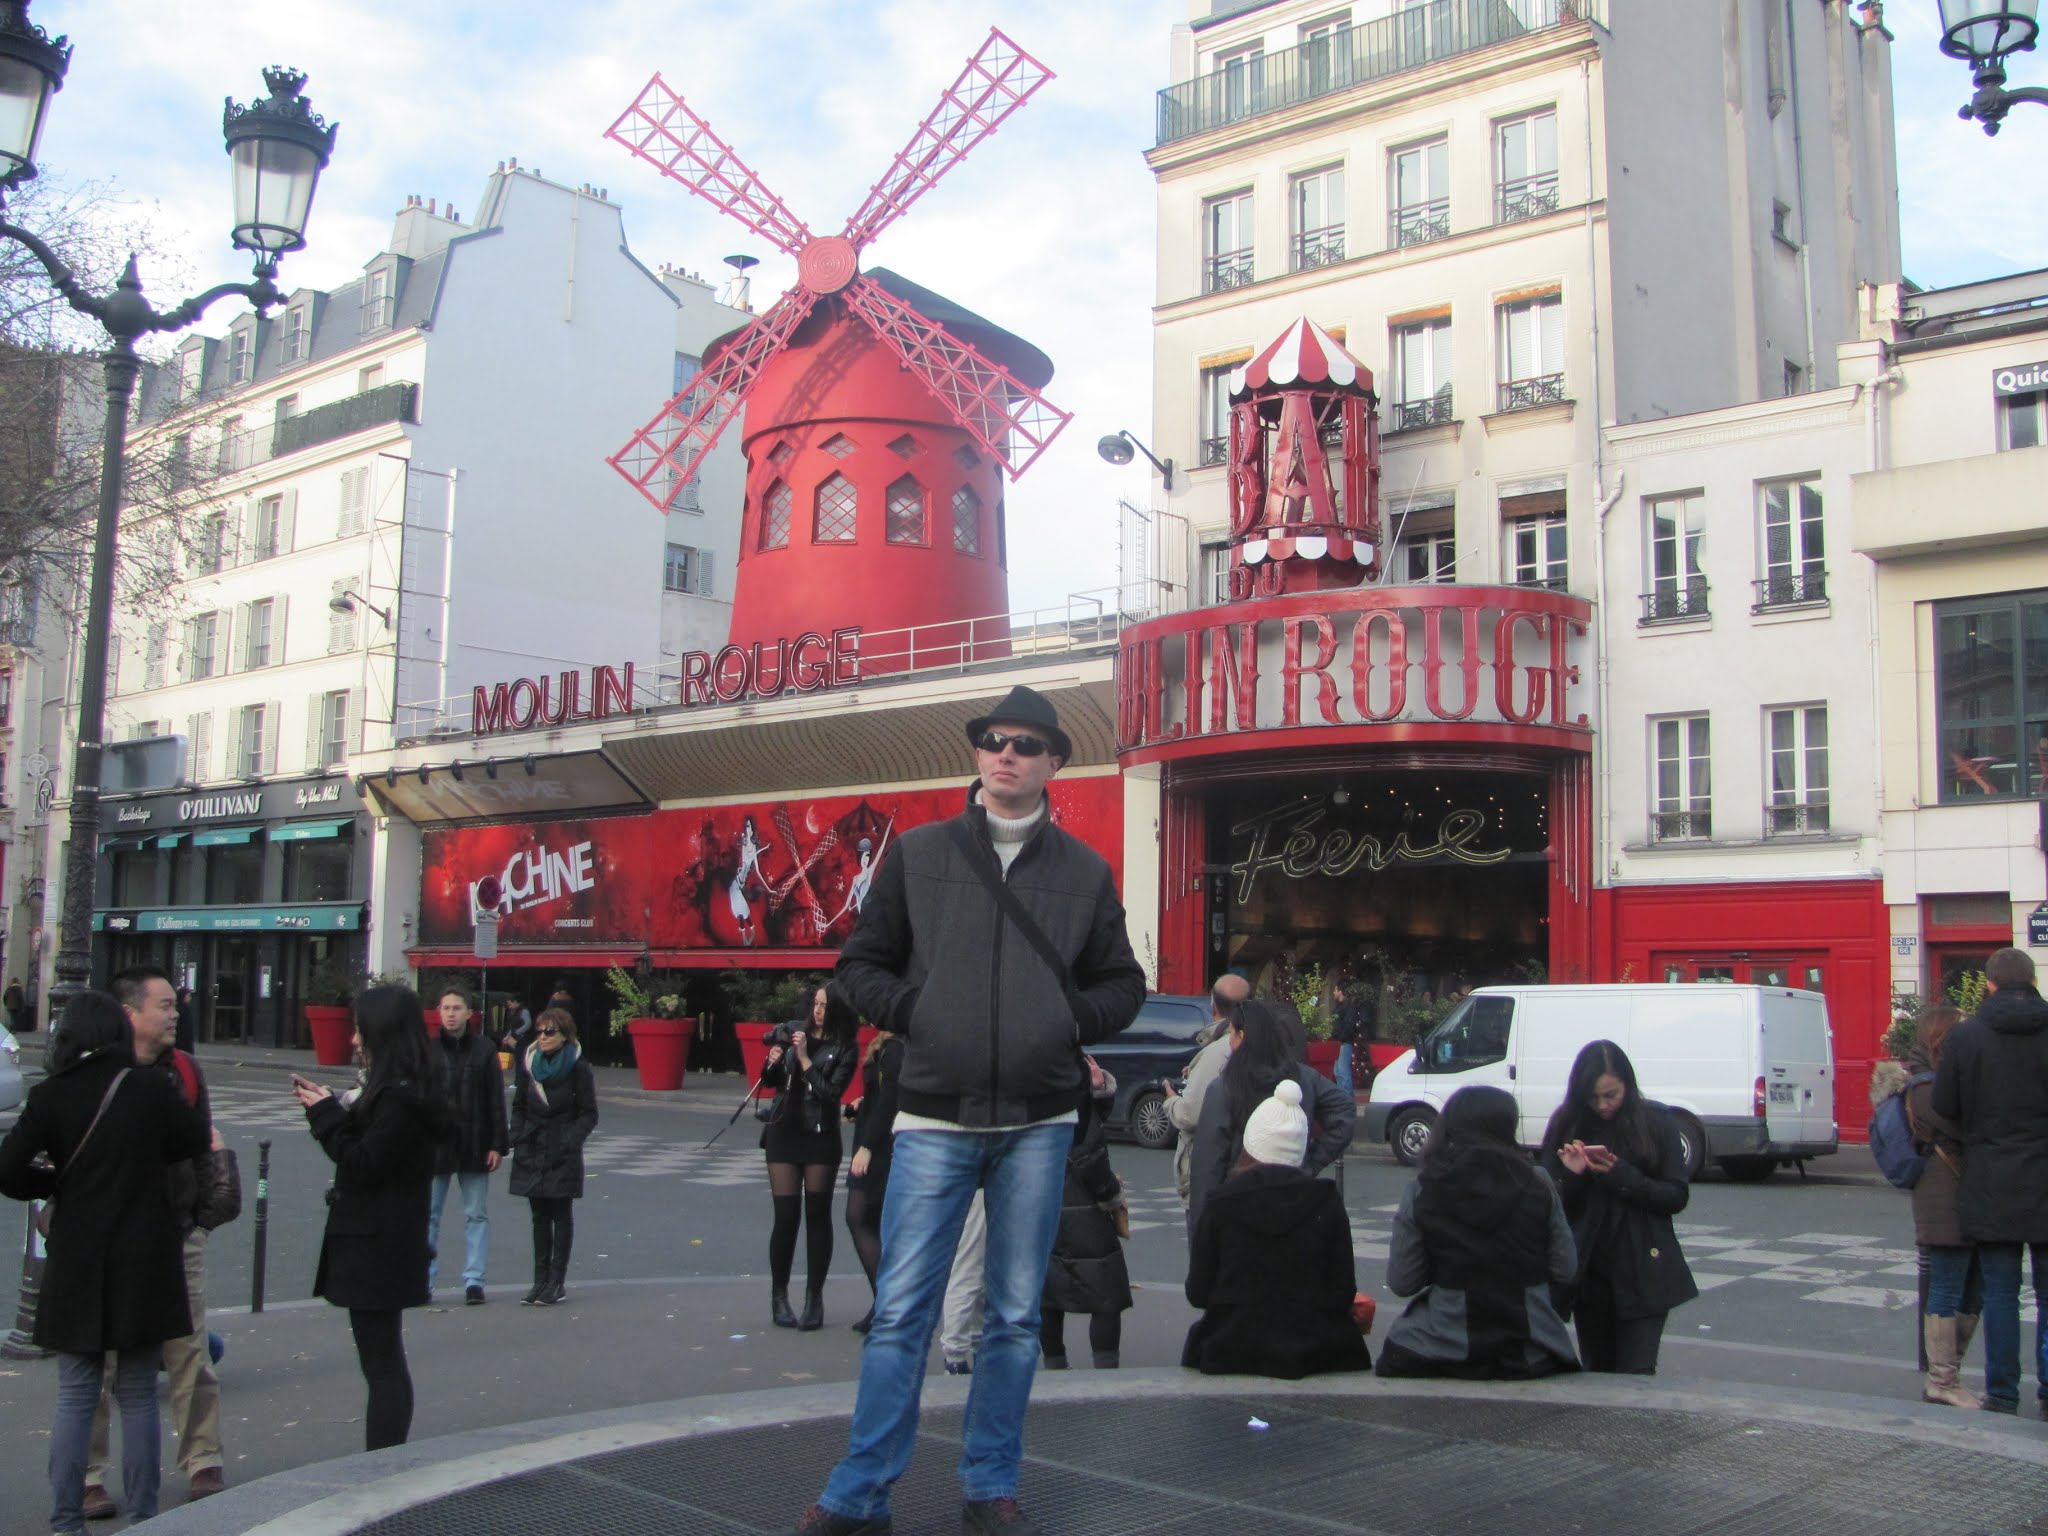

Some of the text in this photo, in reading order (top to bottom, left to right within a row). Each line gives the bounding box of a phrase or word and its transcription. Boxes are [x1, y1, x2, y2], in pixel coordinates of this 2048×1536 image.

[1229, 560, 1286, 599] DU
[472, 625, 863, 737] MOULIN ROUGE
[1280, 606, 1592, 730] ROUGE
[180, 793, 262, 820] O'SULLIVANS
[295, 784, 341, 809] By the Mill
[118, 806, 151, 823] Backstage
